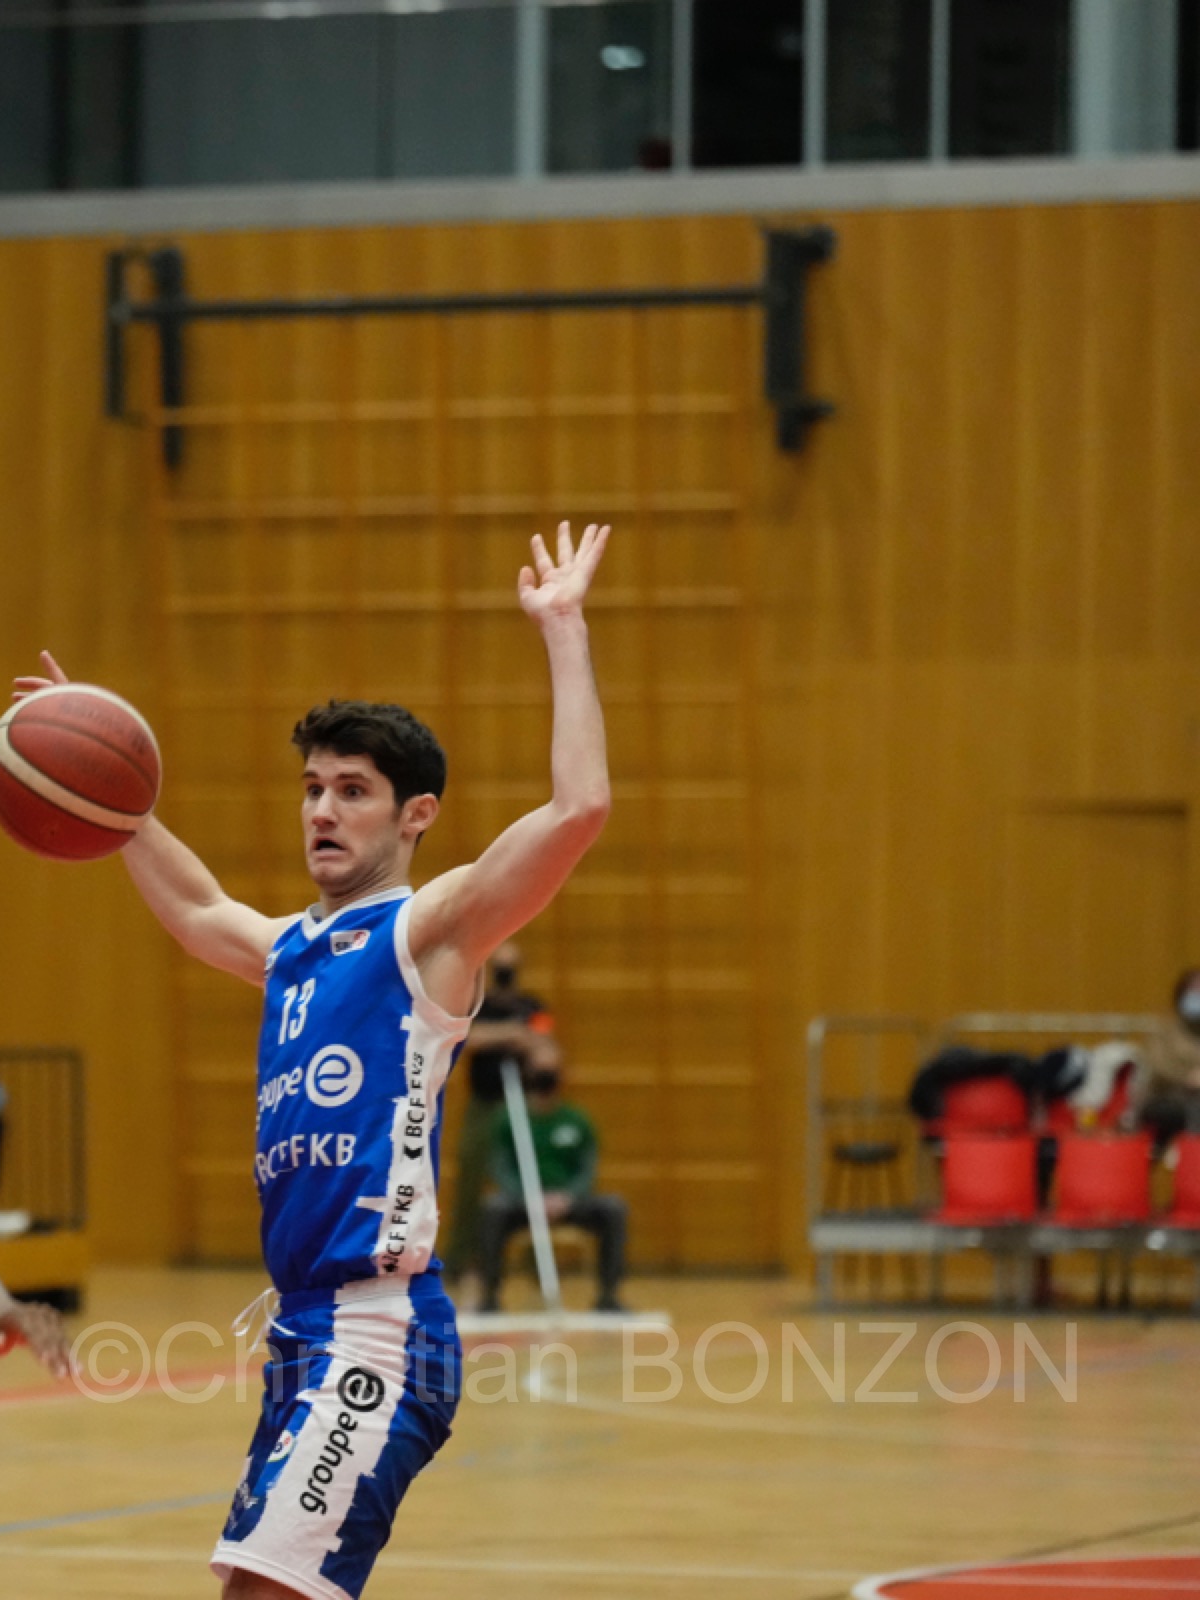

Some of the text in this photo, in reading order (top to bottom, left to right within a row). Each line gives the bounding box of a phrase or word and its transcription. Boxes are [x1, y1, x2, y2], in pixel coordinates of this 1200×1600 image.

[278, 978, 316, 1045] 13
[290, 1132, 357, 1167] FKB
[392, 1185, 415, 1226] FKB
[300, 1411, 358, 1515] groupe
